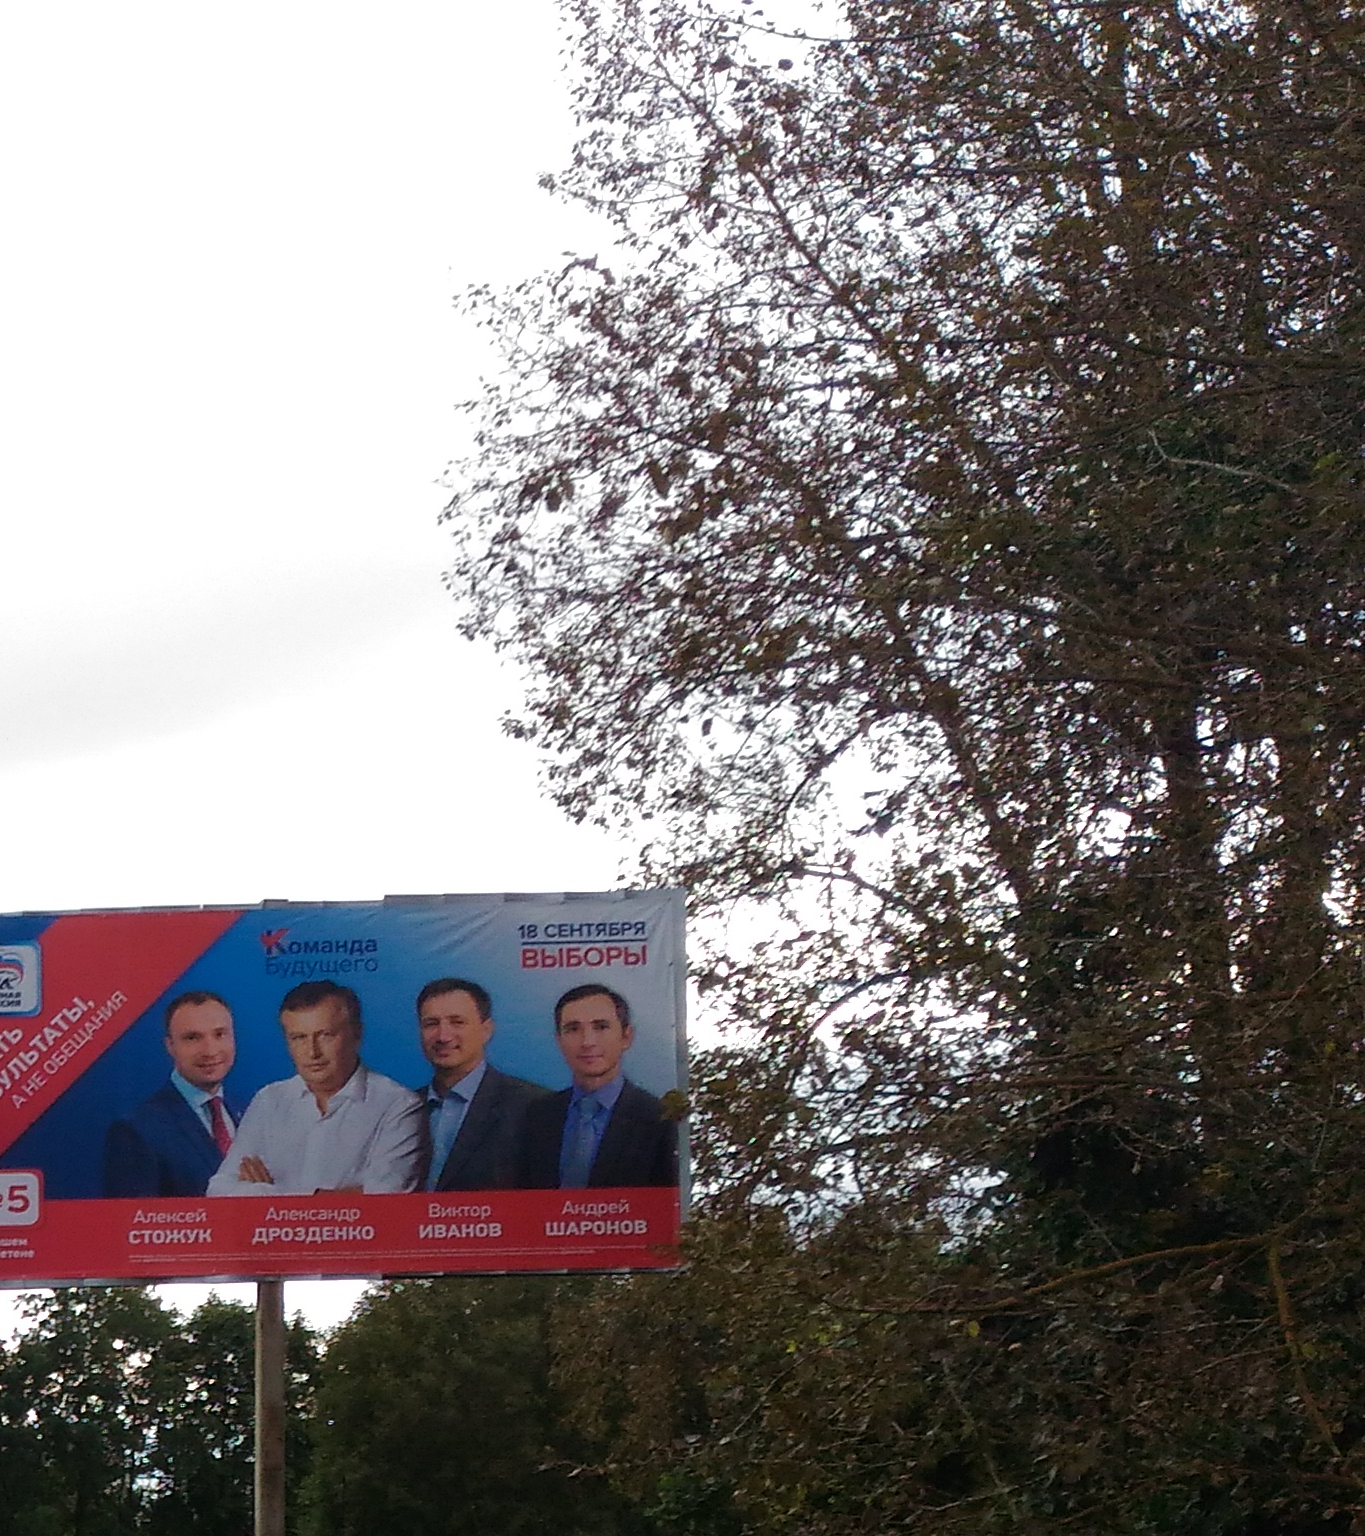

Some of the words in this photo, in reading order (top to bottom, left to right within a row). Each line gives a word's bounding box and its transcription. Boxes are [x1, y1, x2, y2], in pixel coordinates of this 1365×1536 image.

[518, 924, 538, 939] 18
[544, 921, 646, 939] СЕНТЯБРЯ
[260, 928, 379, 956] Команда
[521, 944, 648, 969] ВЫБОРЫ
[265, 956, 379, 979] Будущего
[11, 1094, 28, 1109] А
[21, 1073, 48, 1097] НЕ
[43, 990, 128, 1076] ОБЕЩАНИЯ
[132, 1208, 208, 1225] Алексей
[265, 1207, 361, 1223] Александр
[428, 1203, 492, 1220] Виктор
[561, 1199, 631, 1217] Андрей
[128, 1228, 213, 1246] СТОЖУК
[251, 1225, 376, 1245] ДРОЗДЕНКО
[418, 1223, 503, 1240] ИВАНОВ
[545, 1220, 648, 1237] ШАРОНОВ
